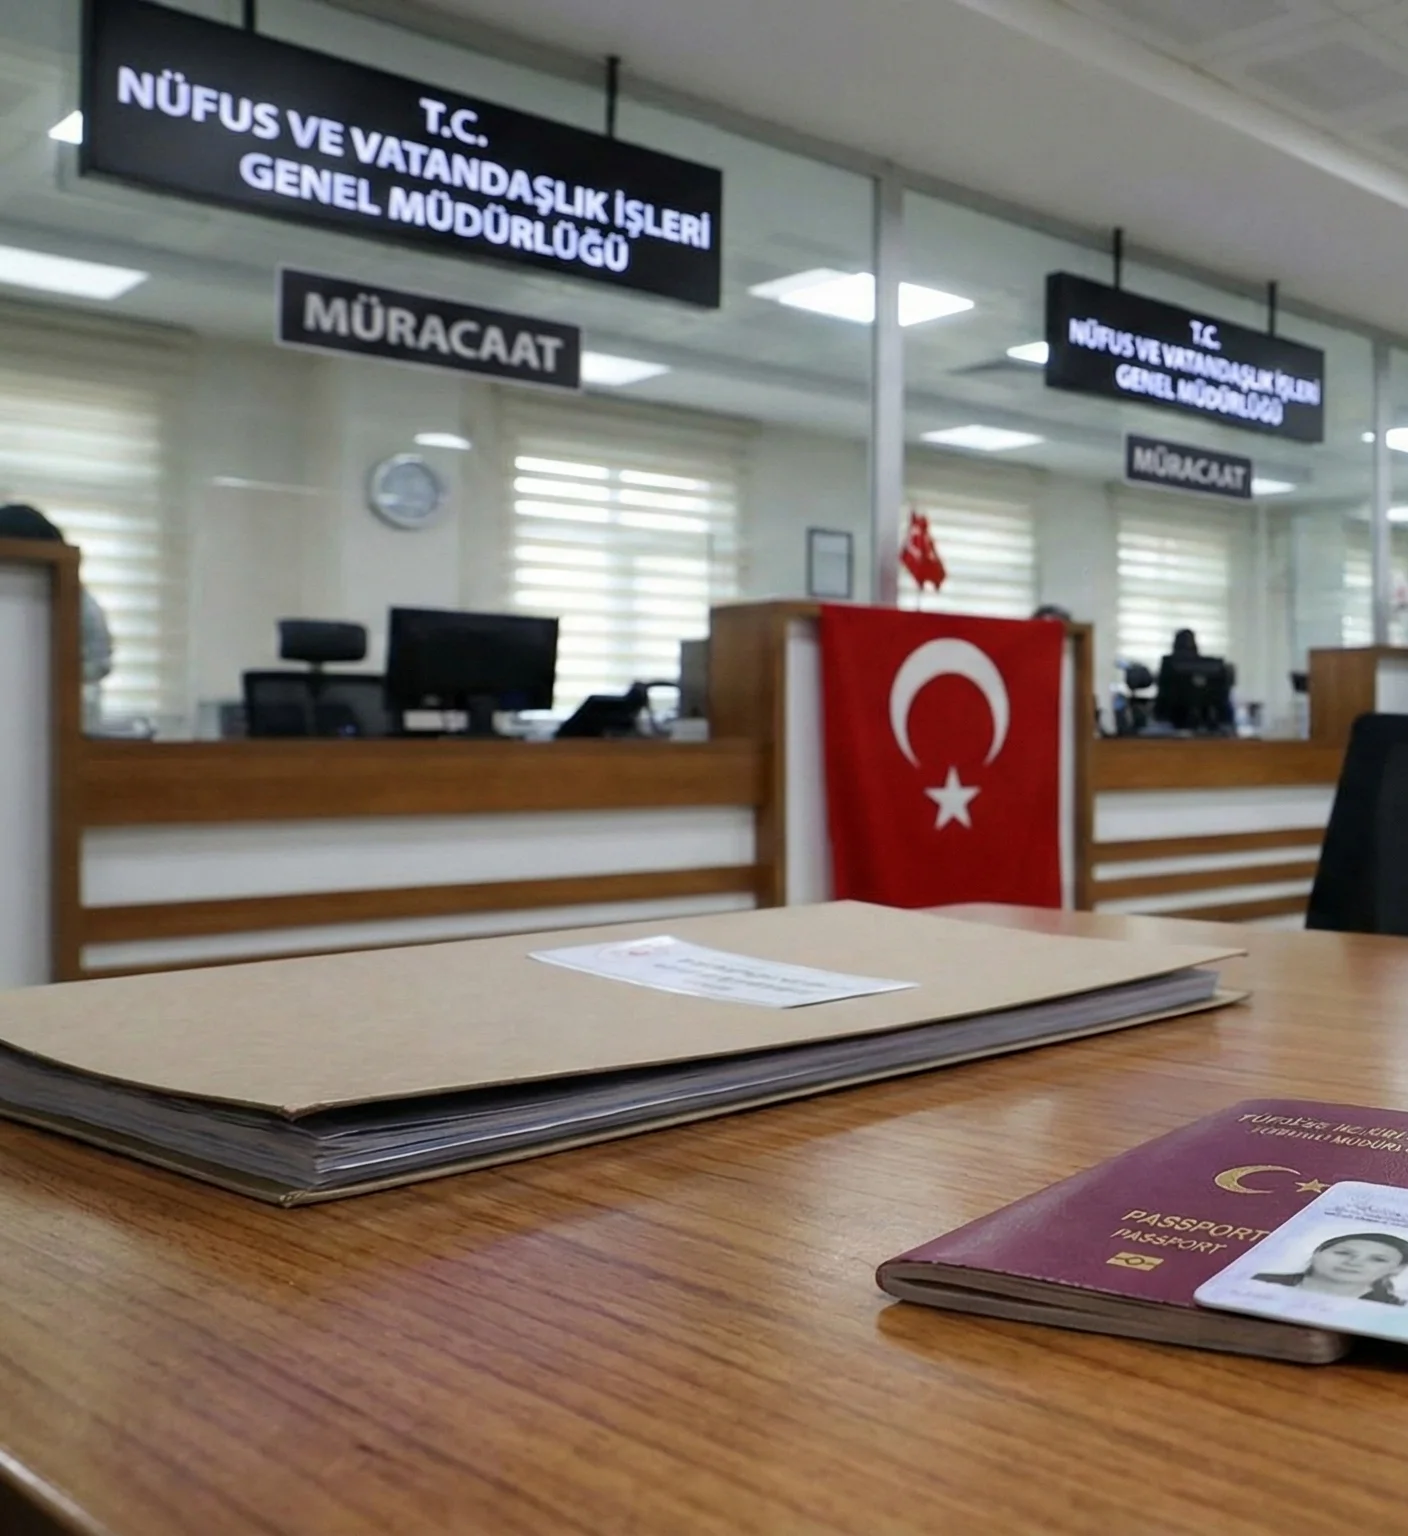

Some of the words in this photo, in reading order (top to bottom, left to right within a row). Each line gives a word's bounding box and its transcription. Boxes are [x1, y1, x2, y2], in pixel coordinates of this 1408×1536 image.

[419, 97, 488, 148] T.C.
[117, 65, 281, 139] NÜFUS
[286, 109, 345, 157] VE
[349, 127, 608, 224] VATANDAŞLIK
[613, 192, 712, 250] İŞLERİ
[239, 152, 381, 215] GENEL
[388, 185, 630, 273] MÜDÜRLÜĞÜ
[303, 291, 564, 374] MÜRACAAT
[1068, 317, 1136, 359] NÜFUS
[1135, 335, 1162, 365] VE
[1115, 363, 1176, 401] GENEL
[1133, 445, 1247, 489] MÜRACAAT
[1110, 1228, 1228, 1255] PASSPORT
[1121, 1209, 1271, 1242] PASSPORT
